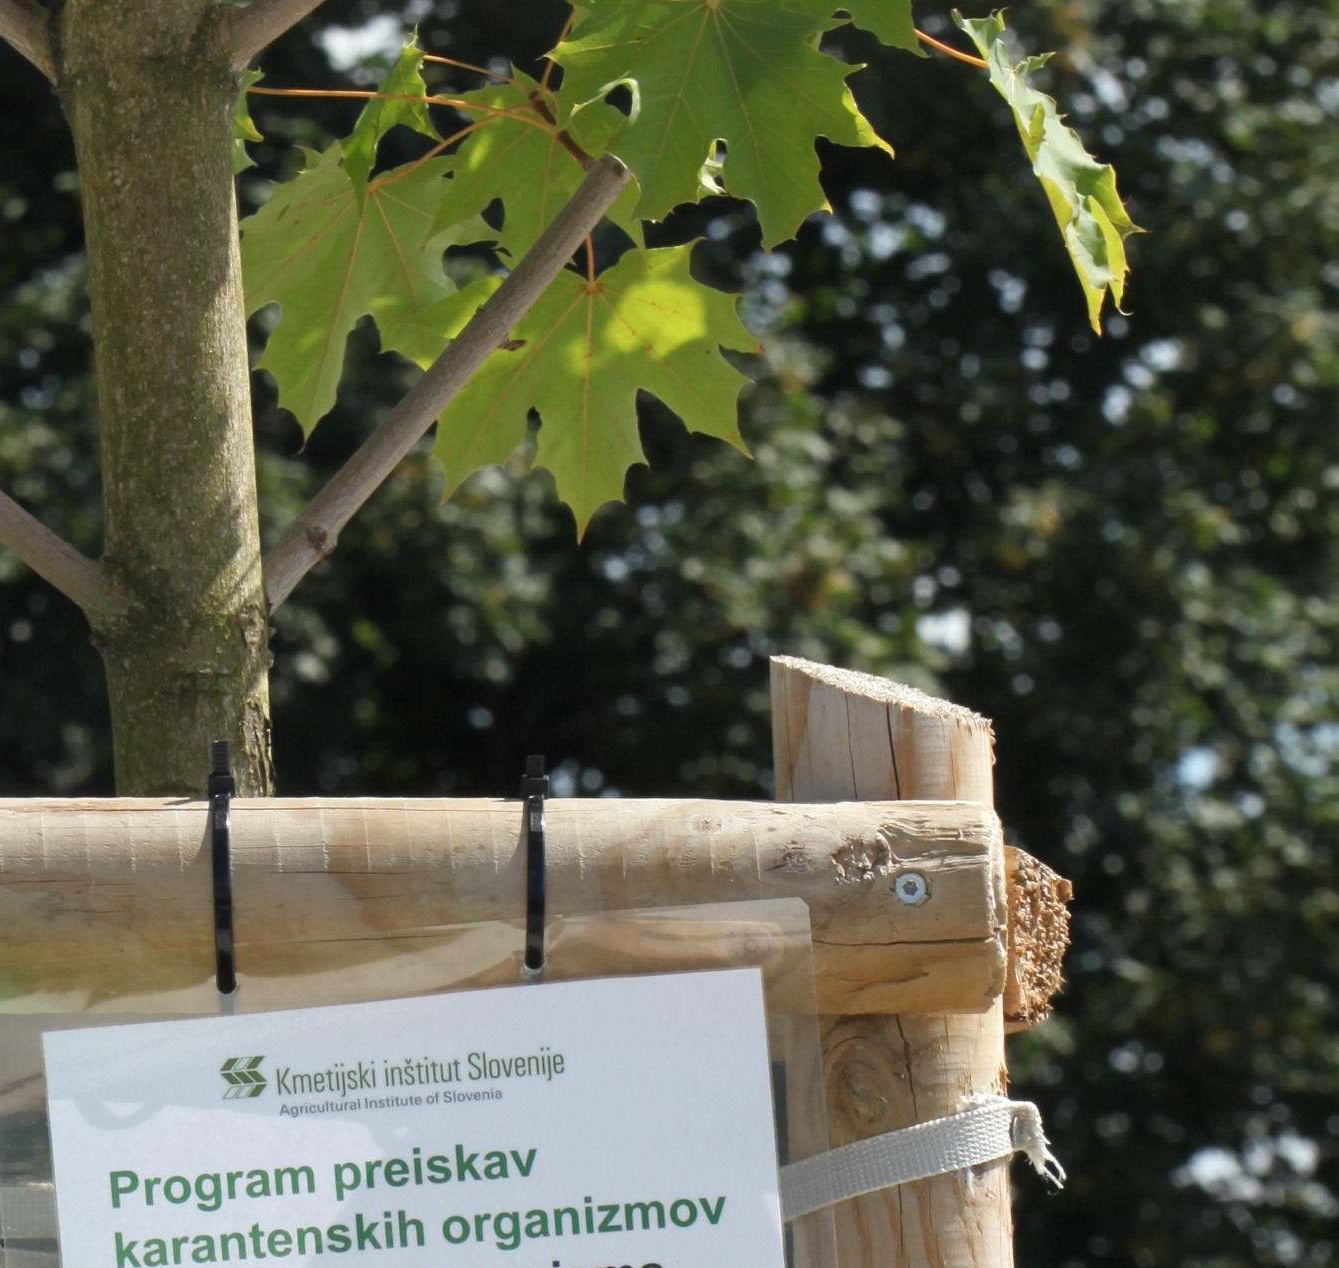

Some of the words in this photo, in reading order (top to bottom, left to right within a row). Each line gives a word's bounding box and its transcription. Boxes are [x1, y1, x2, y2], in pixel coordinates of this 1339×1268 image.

[275, 1060, 377, 1098] Kmetijski
[383, 1056, 462, 1087] inštitut
[467, 1046, 565, 1082] Slovenije
[279, 1098, 361, 1119] Agricultural
[364, 1095, 423, 1110] Institute
[425, 1091, 439, 1105] of
[443, 1089, 503, 1104] Slovenia
[109, 1165, 316, 1213] Program
[333, 1144, 538, 1202] preiskav
[442, 1196, 727, 1251] organizmov
